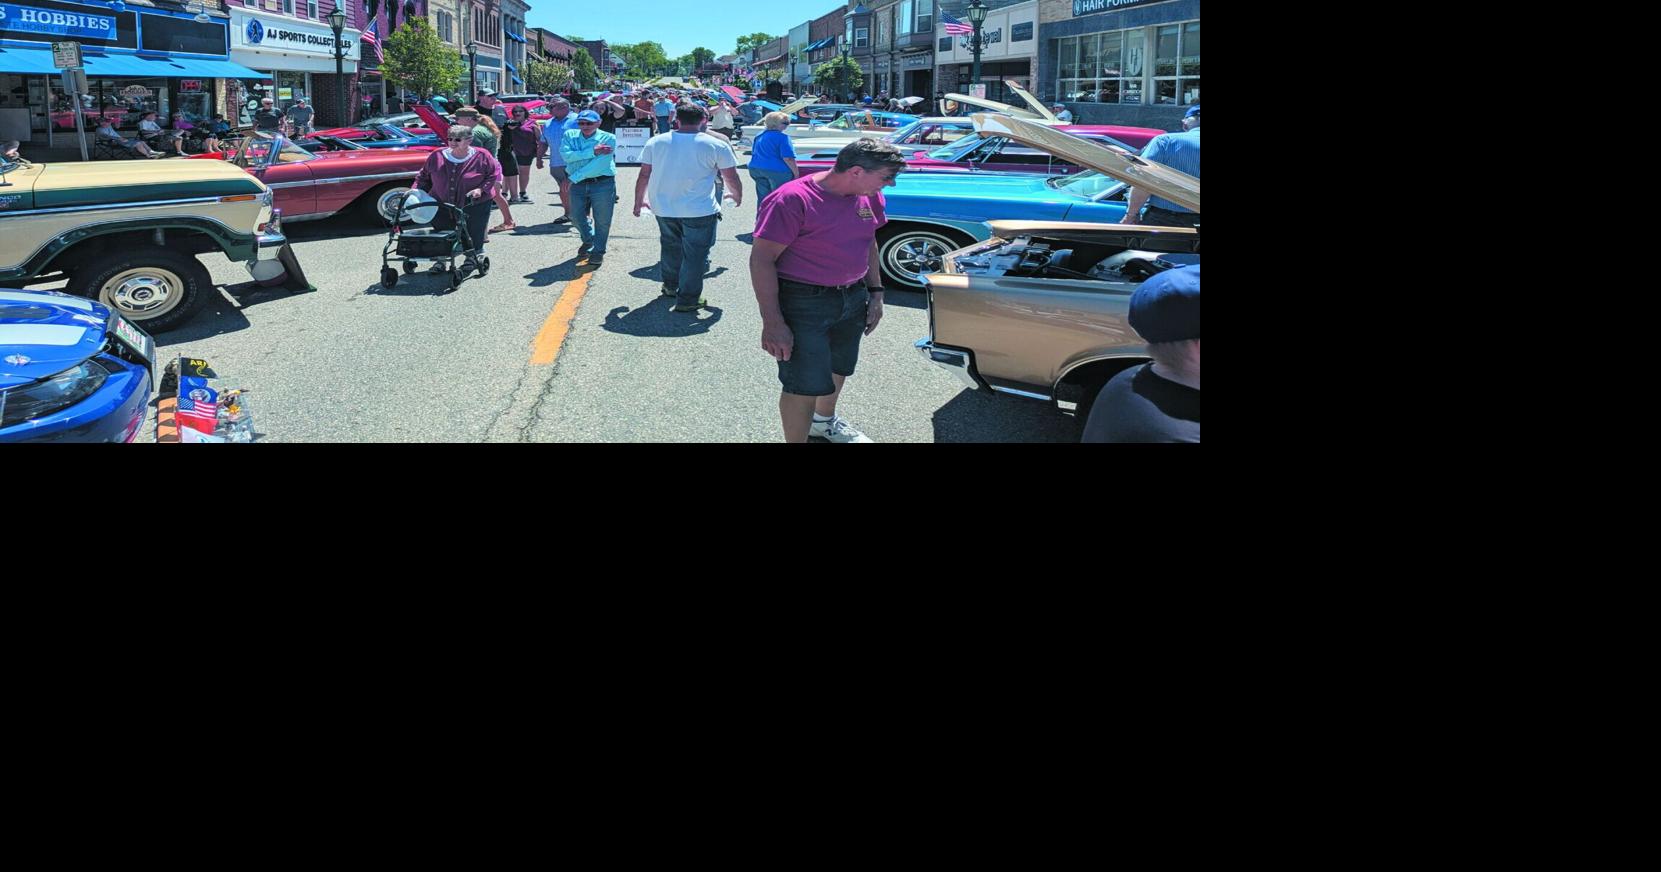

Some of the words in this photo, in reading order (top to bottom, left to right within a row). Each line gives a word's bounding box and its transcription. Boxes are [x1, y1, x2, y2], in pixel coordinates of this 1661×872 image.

[1082, 0, 1104, 12] HAIR
[20, 9, 110, 30] HOBBIES
[267, 28, 277, 39] AJ
[279, 30, 306, 43] SPORTS
[308, 34, 352, 48] COLLECTLES
